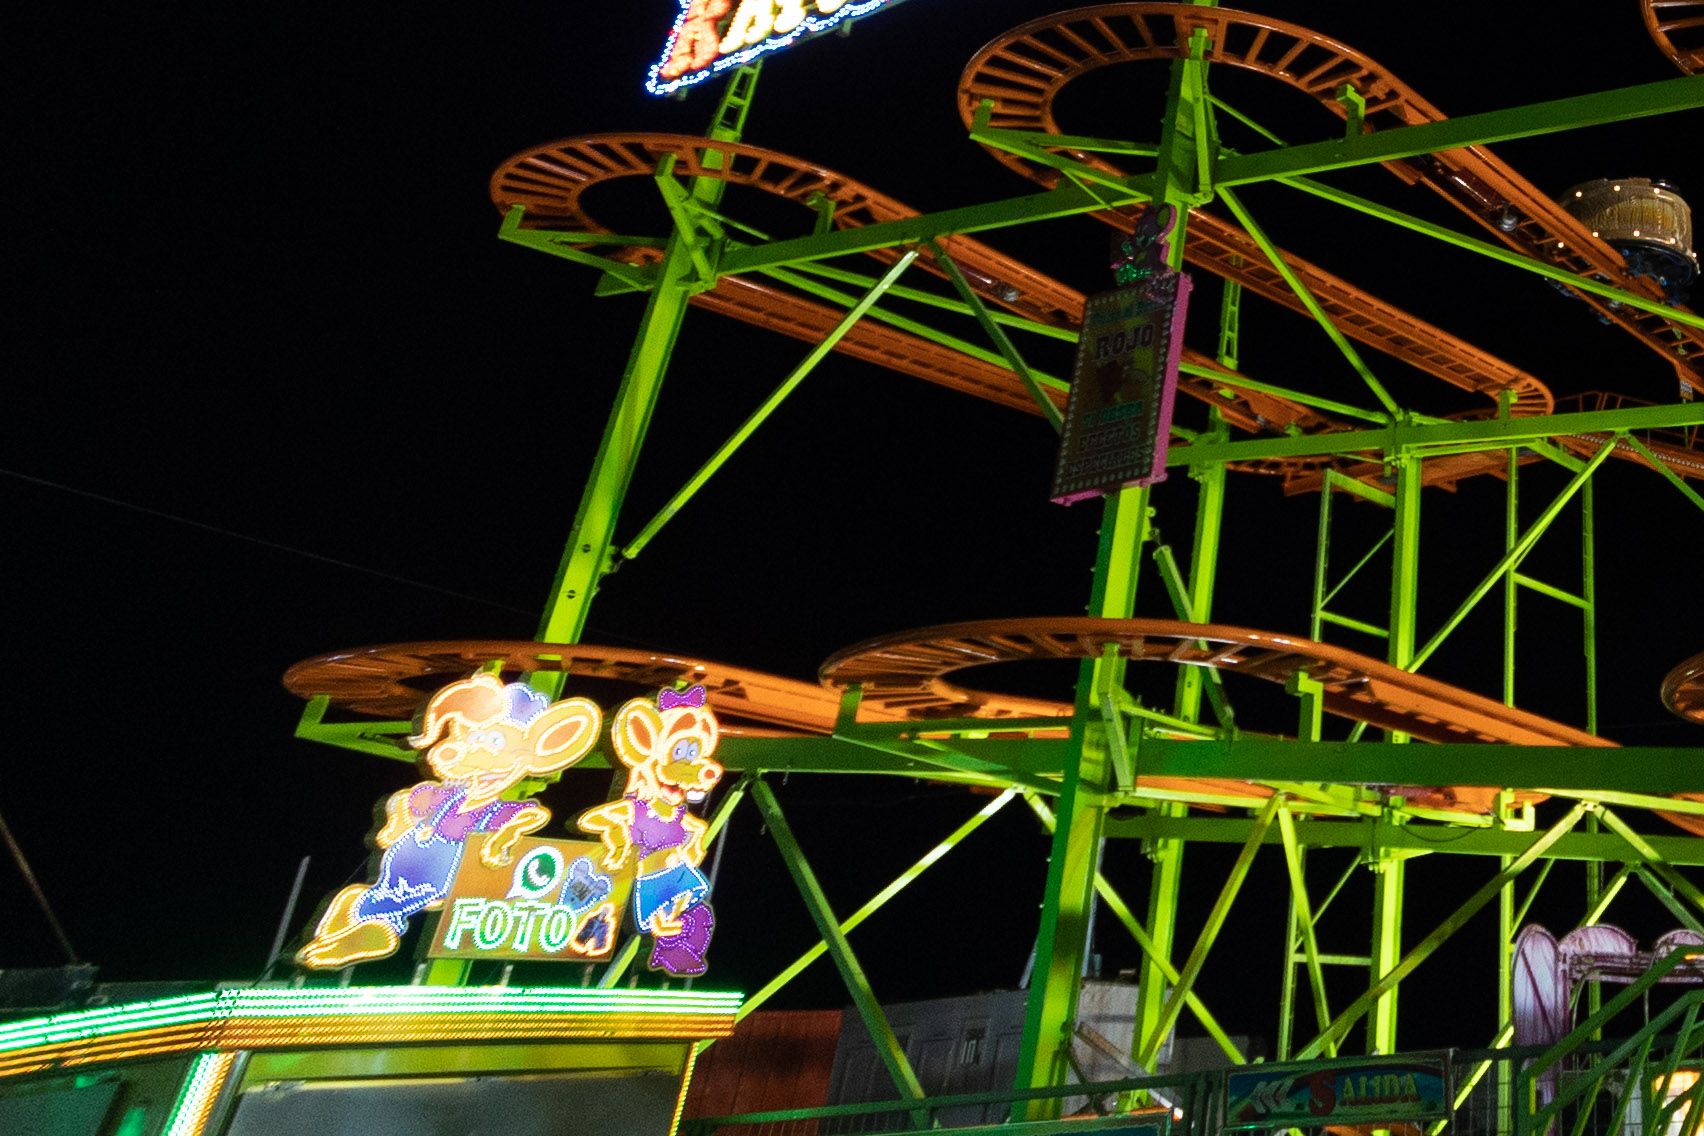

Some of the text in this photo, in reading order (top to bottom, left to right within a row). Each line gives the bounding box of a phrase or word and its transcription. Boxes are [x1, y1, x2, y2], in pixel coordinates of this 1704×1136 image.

[1096, 324, 1154, 361] ROJO
[443, 897, 577, 953] FOTO
[1309, 1070, 1421, 1115] SALIDA
